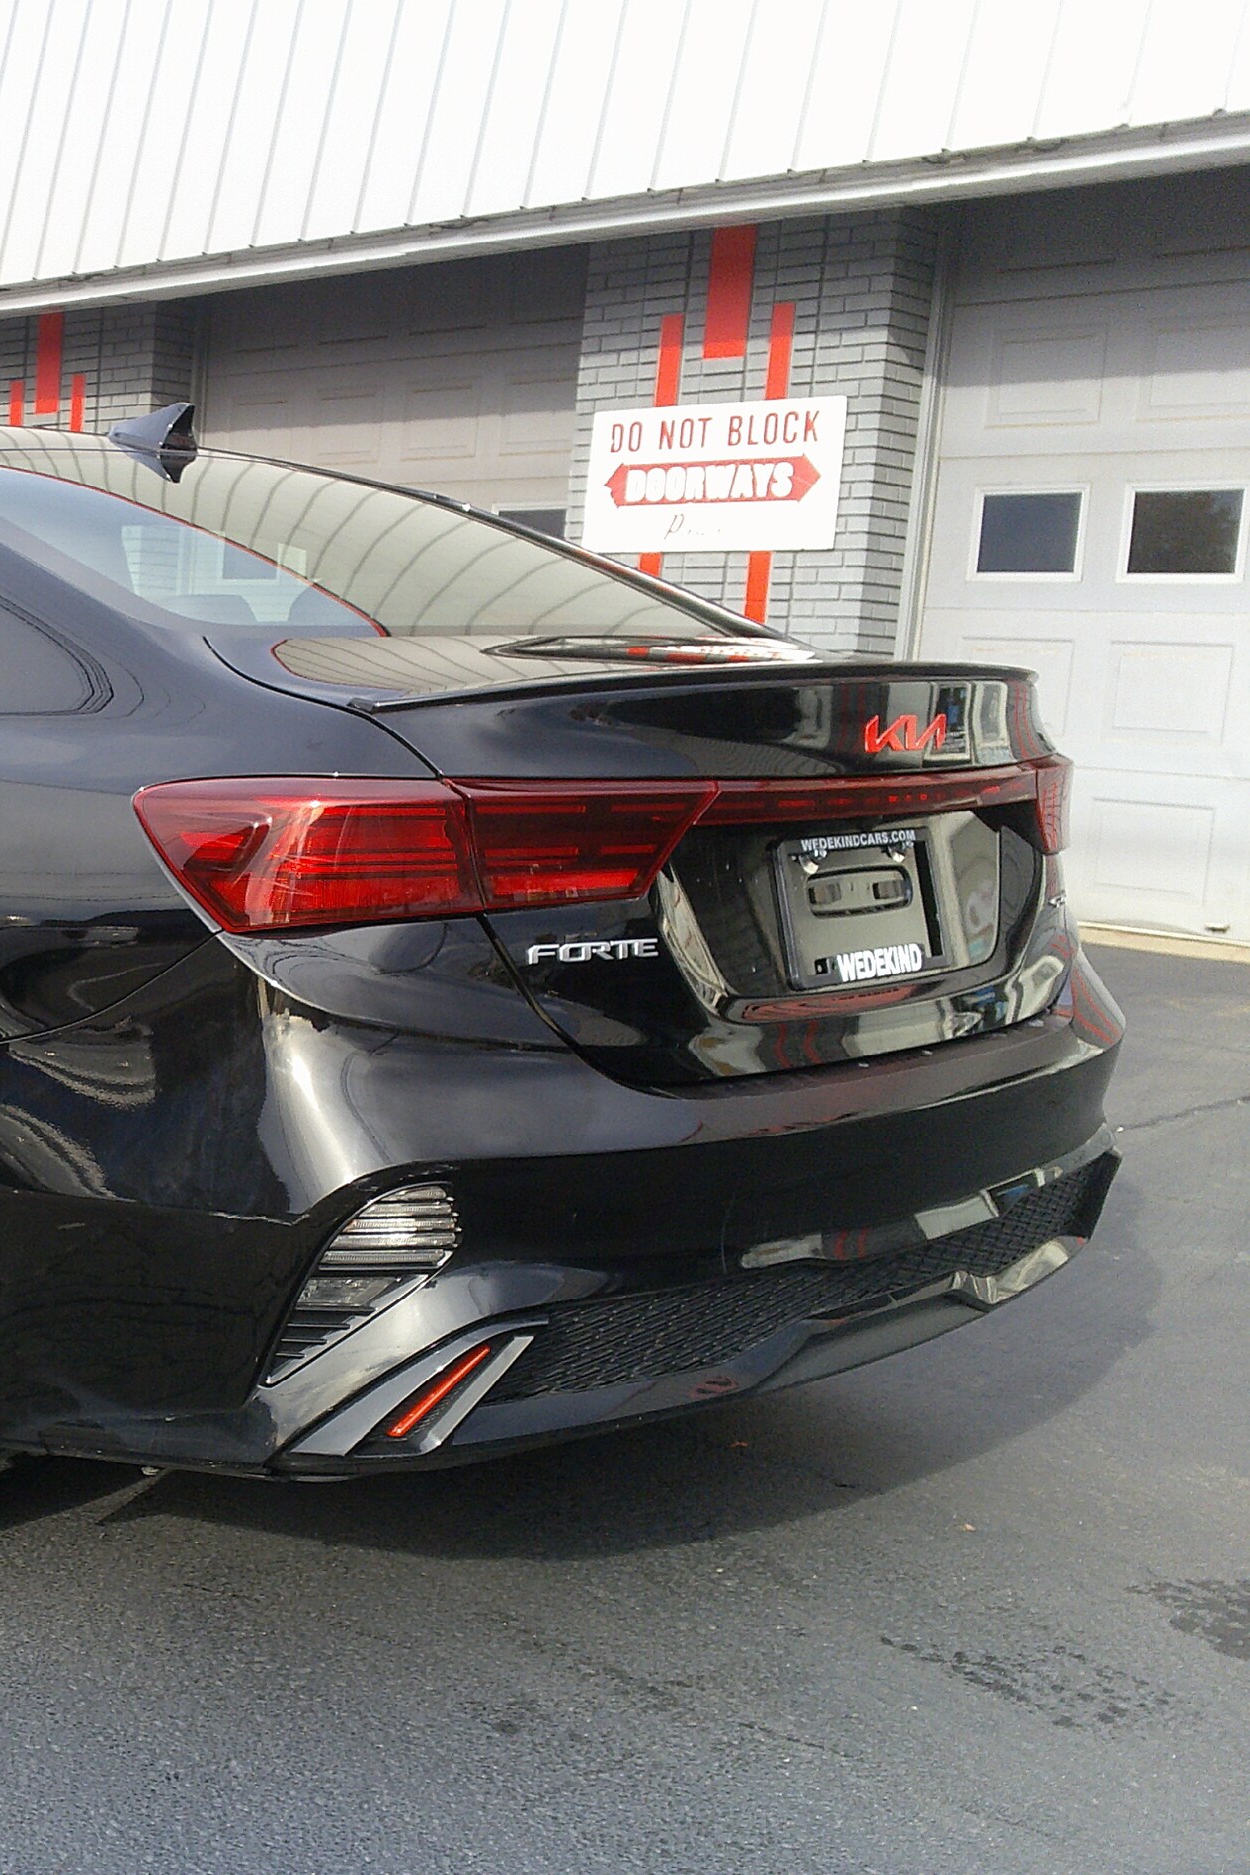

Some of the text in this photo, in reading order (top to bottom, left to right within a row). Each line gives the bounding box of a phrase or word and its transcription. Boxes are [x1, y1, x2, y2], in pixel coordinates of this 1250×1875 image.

[611, 411, 820, 453] DO NOT BLOCK
[624, 461, 794, 504] DOORWAYS
[800, 829, 917, 852] WEDEKINDCARS.COM
[527, 938, 659, 966] FORTE
[836, 942, 923, 983] WEDEKIND
